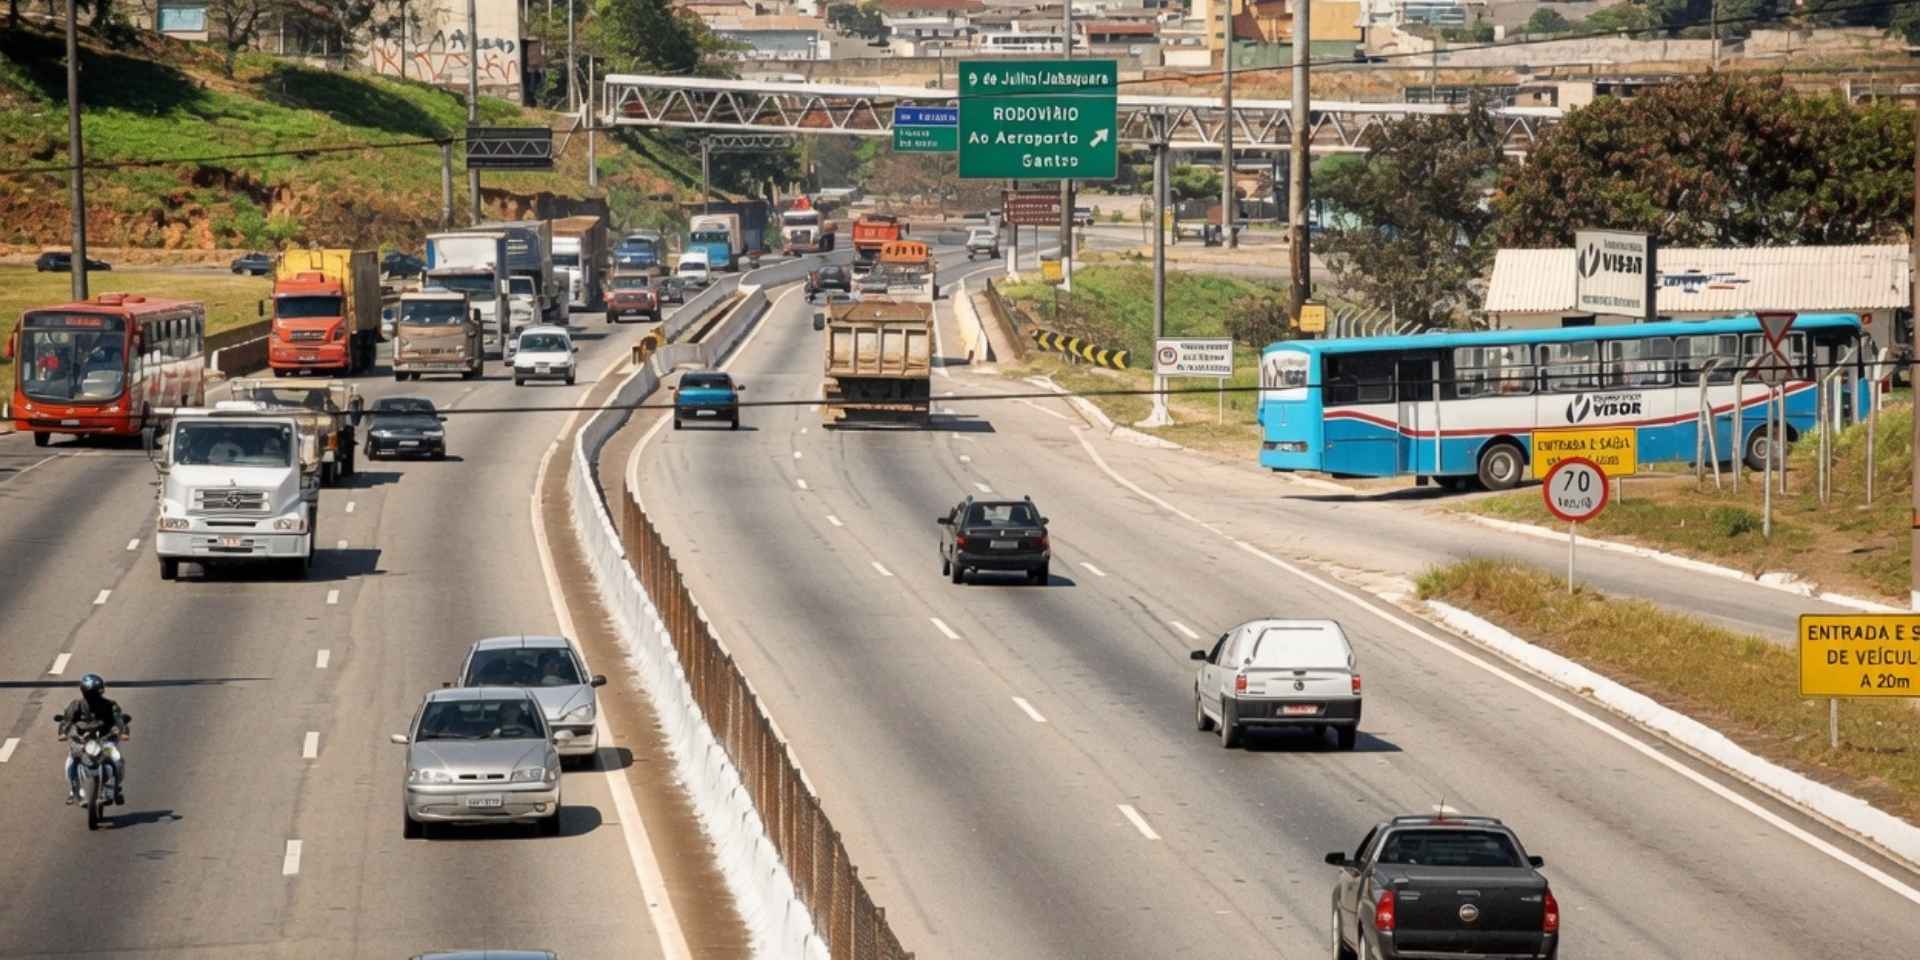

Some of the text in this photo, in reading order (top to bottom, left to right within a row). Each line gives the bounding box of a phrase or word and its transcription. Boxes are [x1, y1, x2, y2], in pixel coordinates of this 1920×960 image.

[968, 131, 1079, 147] Ao Aeroporto
[1563, 470, 1590, 492] 70
[1808, 624, 1889, 640] ENTRADA
[1895, 624, 1905, 640] E
[1827, 649, 1849, 665] DE
[1860, 673, 1910, 688] A 20m
